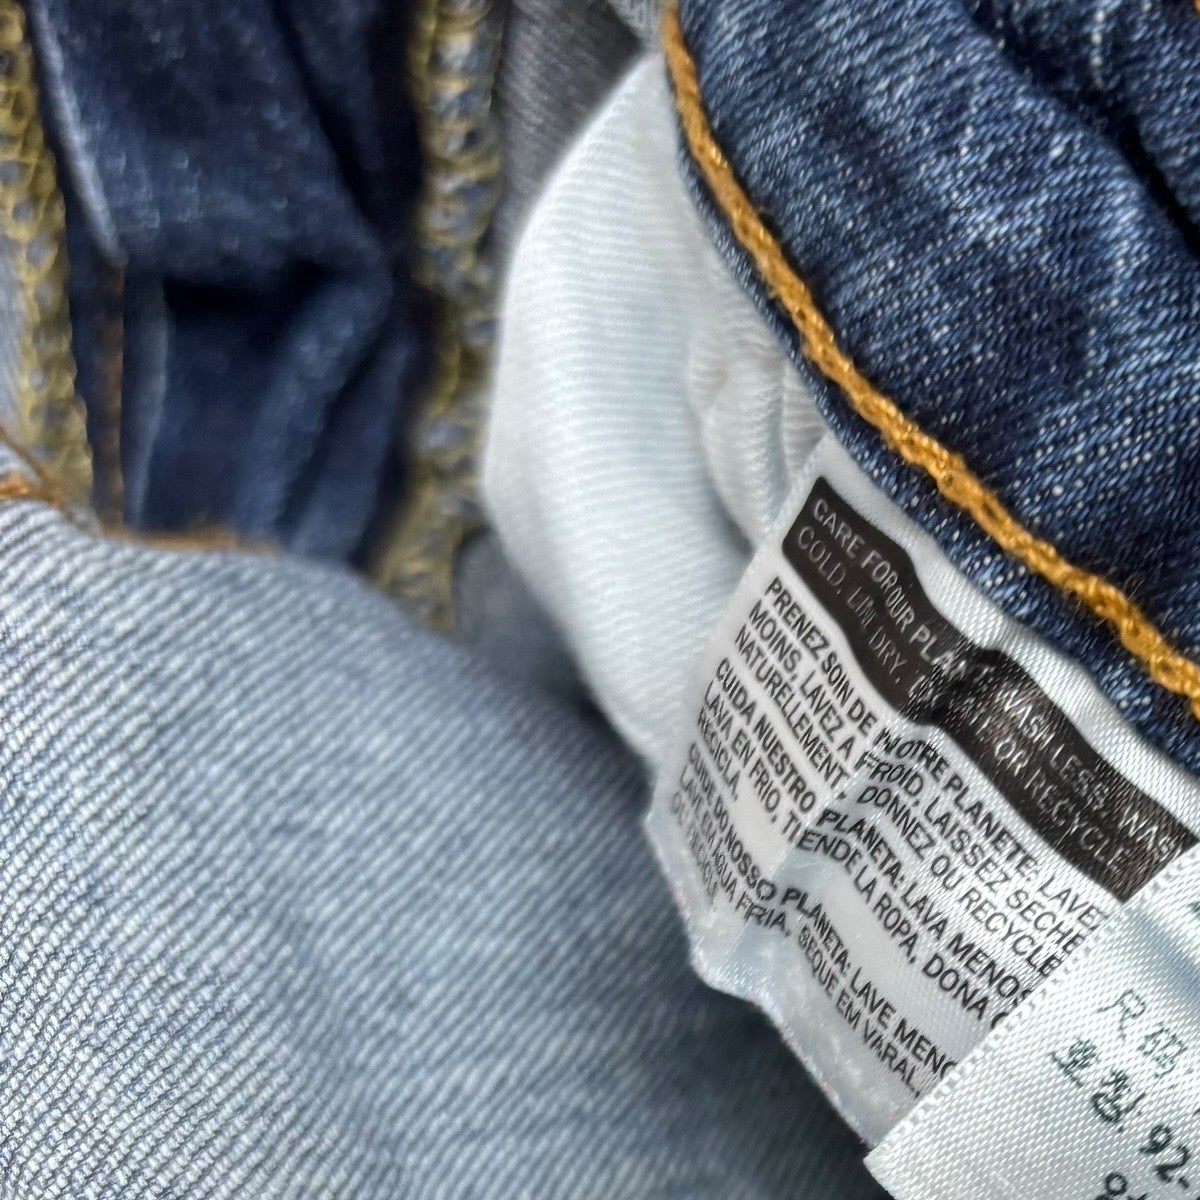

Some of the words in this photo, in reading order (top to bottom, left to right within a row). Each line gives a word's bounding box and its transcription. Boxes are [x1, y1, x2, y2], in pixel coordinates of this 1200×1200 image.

[731, 627, 857, 800] NATURELLEMENT,
[856, 782, 935, 859] DONNEZ
[927, 852, 966, 892] OU
[744, 601, 808, 682] MOINS,
[796, 673, 847, 741] LAVEZ
[836, 736, 859, 758] A
[853, 752, 933, 806] FROID,
[921, 798, 1010, 894] LAISSEZ
[763, 577, 832, 658] PRENEZ
[817, 652, 857, 707] SOIN
[847, 697, 879, 735] DE
[872, 728, 951, 780] NOTRE
[945, 776, 1043, 883] PLANETE:
[809, 499, 866, 558] CARE
[859, 549, 901, 592] FOR
[883, 586, 917, 631] OUR
[992, 682, 1057, 749] WASH
[846, 587, 881, 628] LIN
[991, 736, 1030, 775] OR
[1021, 768, 1131, 872] RECYCLE
[700, 680, 739, 738] LAVA
[728, 731, 756, 767] EN
[744, 760, 789, 822] FRIO,
[777, 812, 864, 873] TIENDE
[849, 866, 882, 898] LA
[869, 895, 927, 963] ROPA,
[920, 953, 994, 1020] DONA
[713, 658, 762, 721] CUIDA
[750, 715, 821, 813] NUESTRO
[815, 804, 913, 888] PLANETA:
[900, 885, 952, 939] LAVA
[724, 824, 777, 901] NOSSO
[780, 884, 857, 974] PLANETA:
[848, 968, 896, 1025] LAVE
[795, 926, 842, 993] SEQUE
[833, 988, 869, 1027] EM
